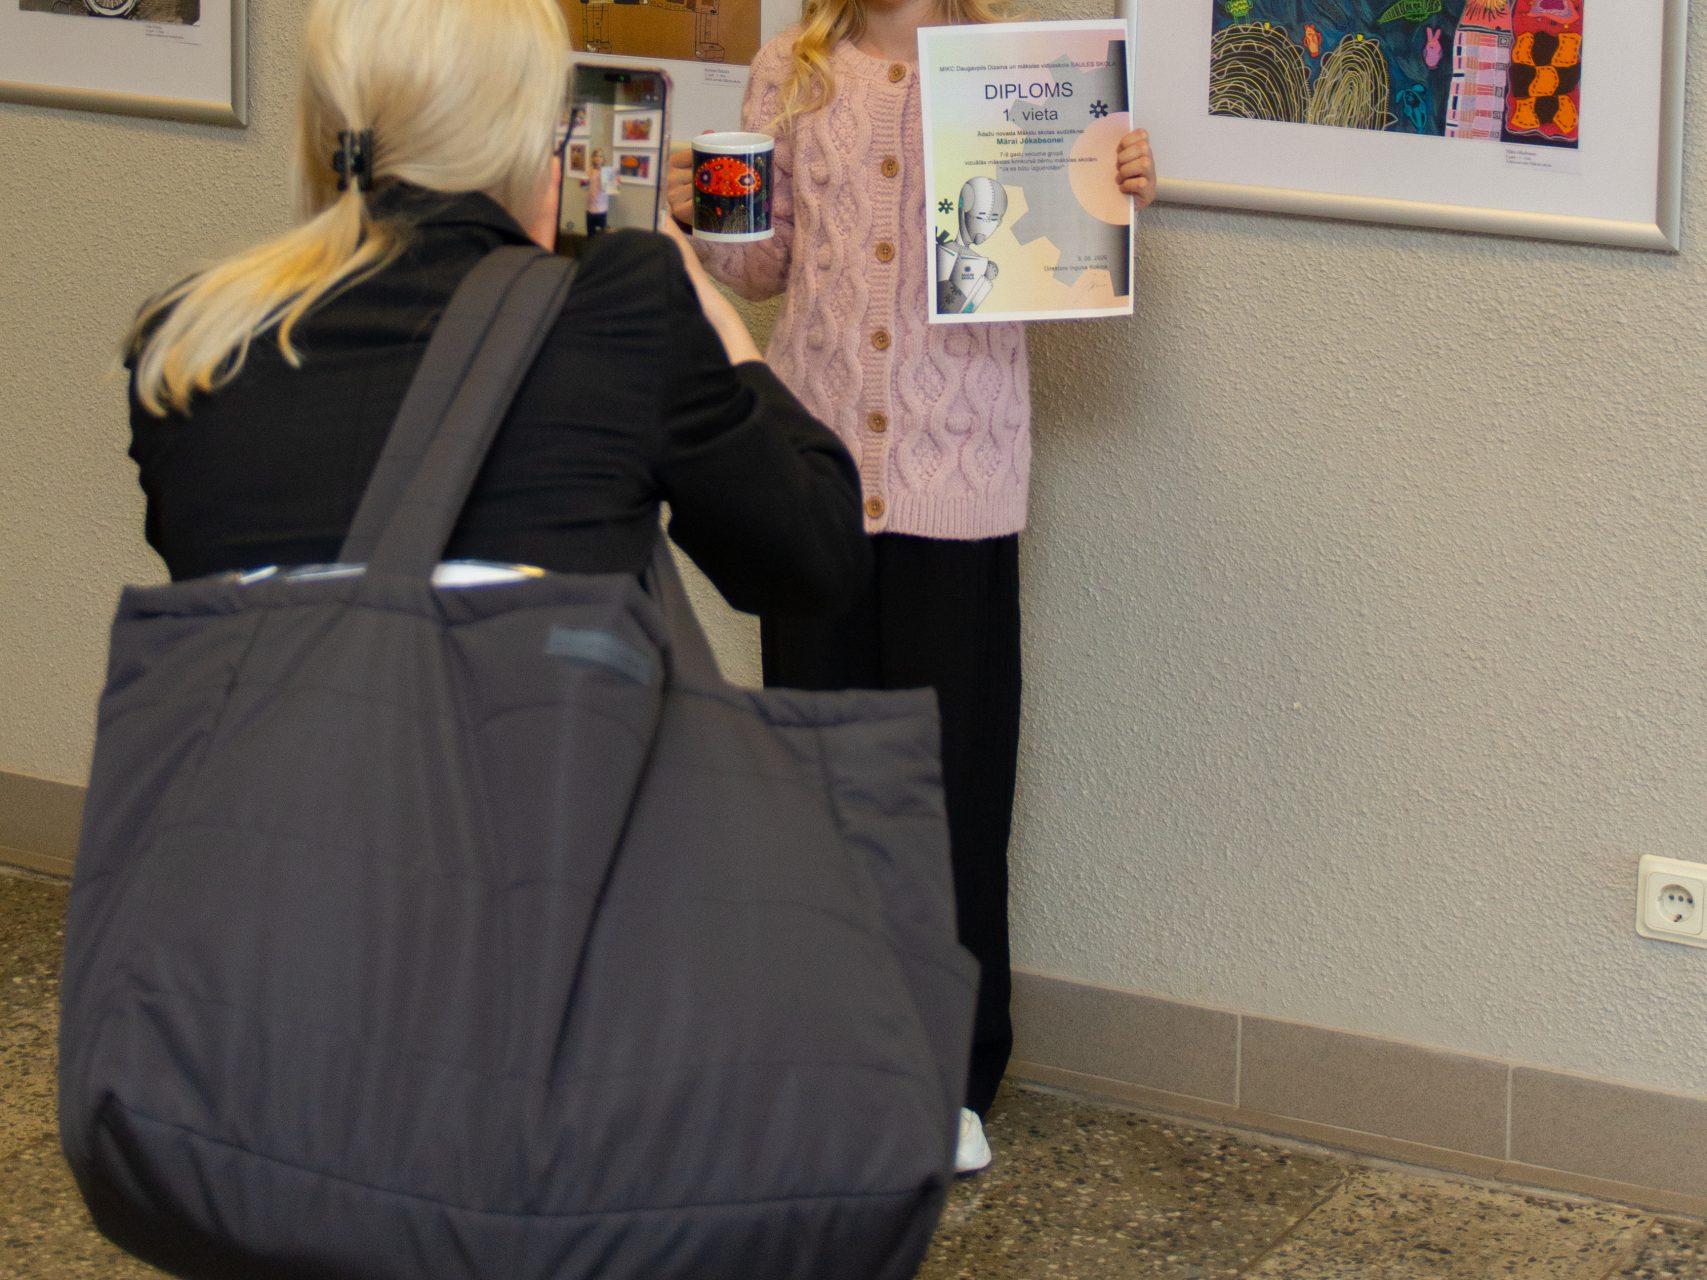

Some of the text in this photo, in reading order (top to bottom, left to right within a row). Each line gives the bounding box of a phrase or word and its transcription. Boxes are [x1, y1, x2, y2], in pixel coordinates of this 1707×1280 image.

[985, 81, 1074, 100] DIPLOMS
[1003, 108, 1058, 122] 1. vieta
